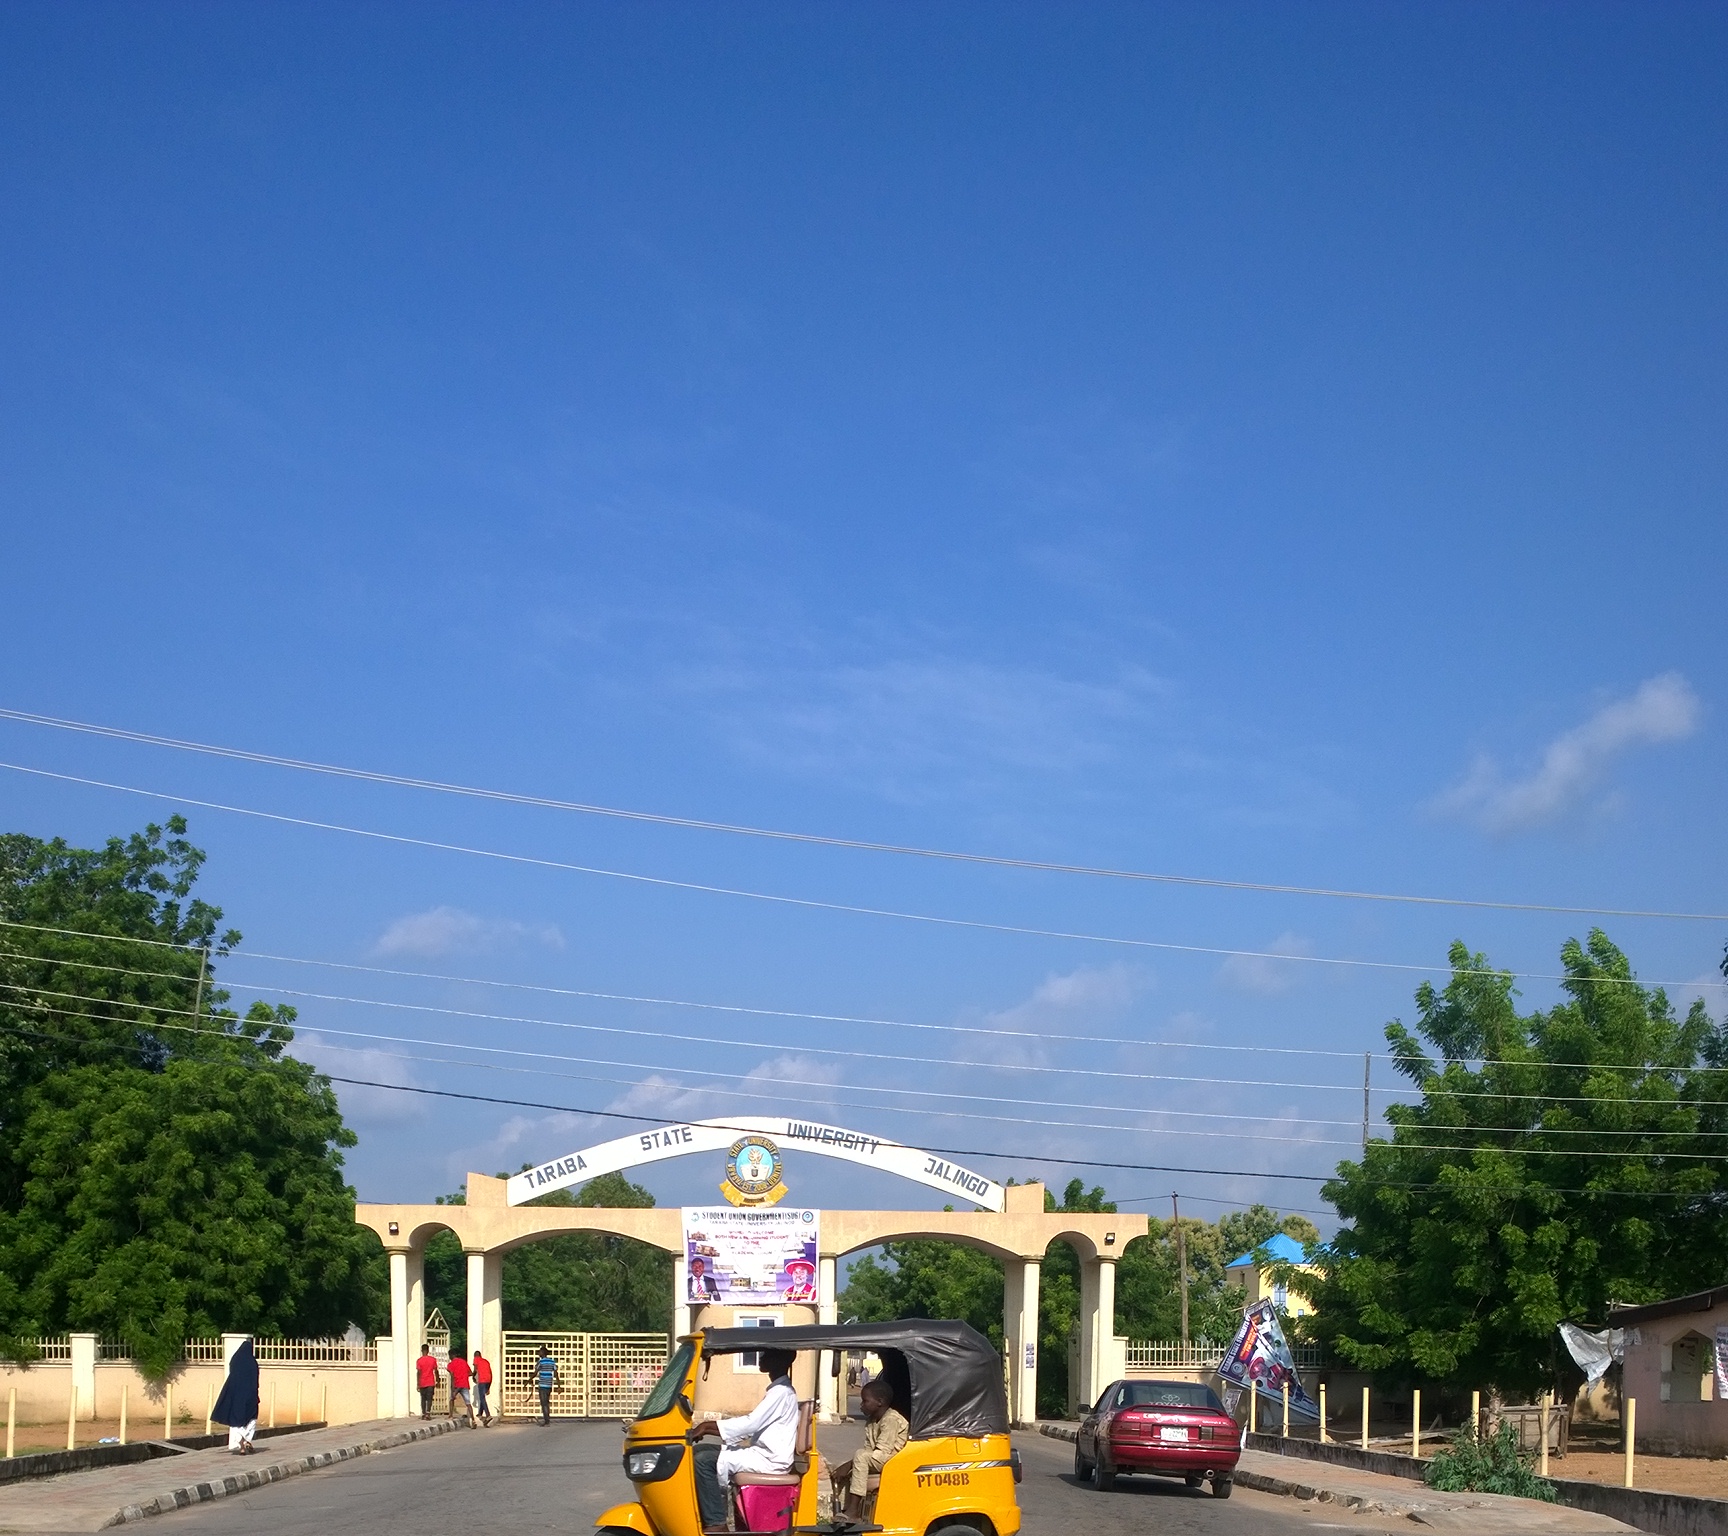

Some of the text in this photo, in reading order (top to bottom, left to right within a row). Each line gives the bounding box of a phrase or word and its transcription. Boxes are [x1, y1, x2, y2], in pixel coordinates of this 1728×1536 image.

[728, 1141, 744, 1158] STATE
[747, 1137, 779, 1155] UNIVERSITY
[524, 1122, 989, 1197] TARABA STATE UNIVERSITY JALINGO
[702, 1211, 728, 1220] STUDENT
[728, 1212, 747, 1221] UNION
[917, 1474, 932, 1488] PT
